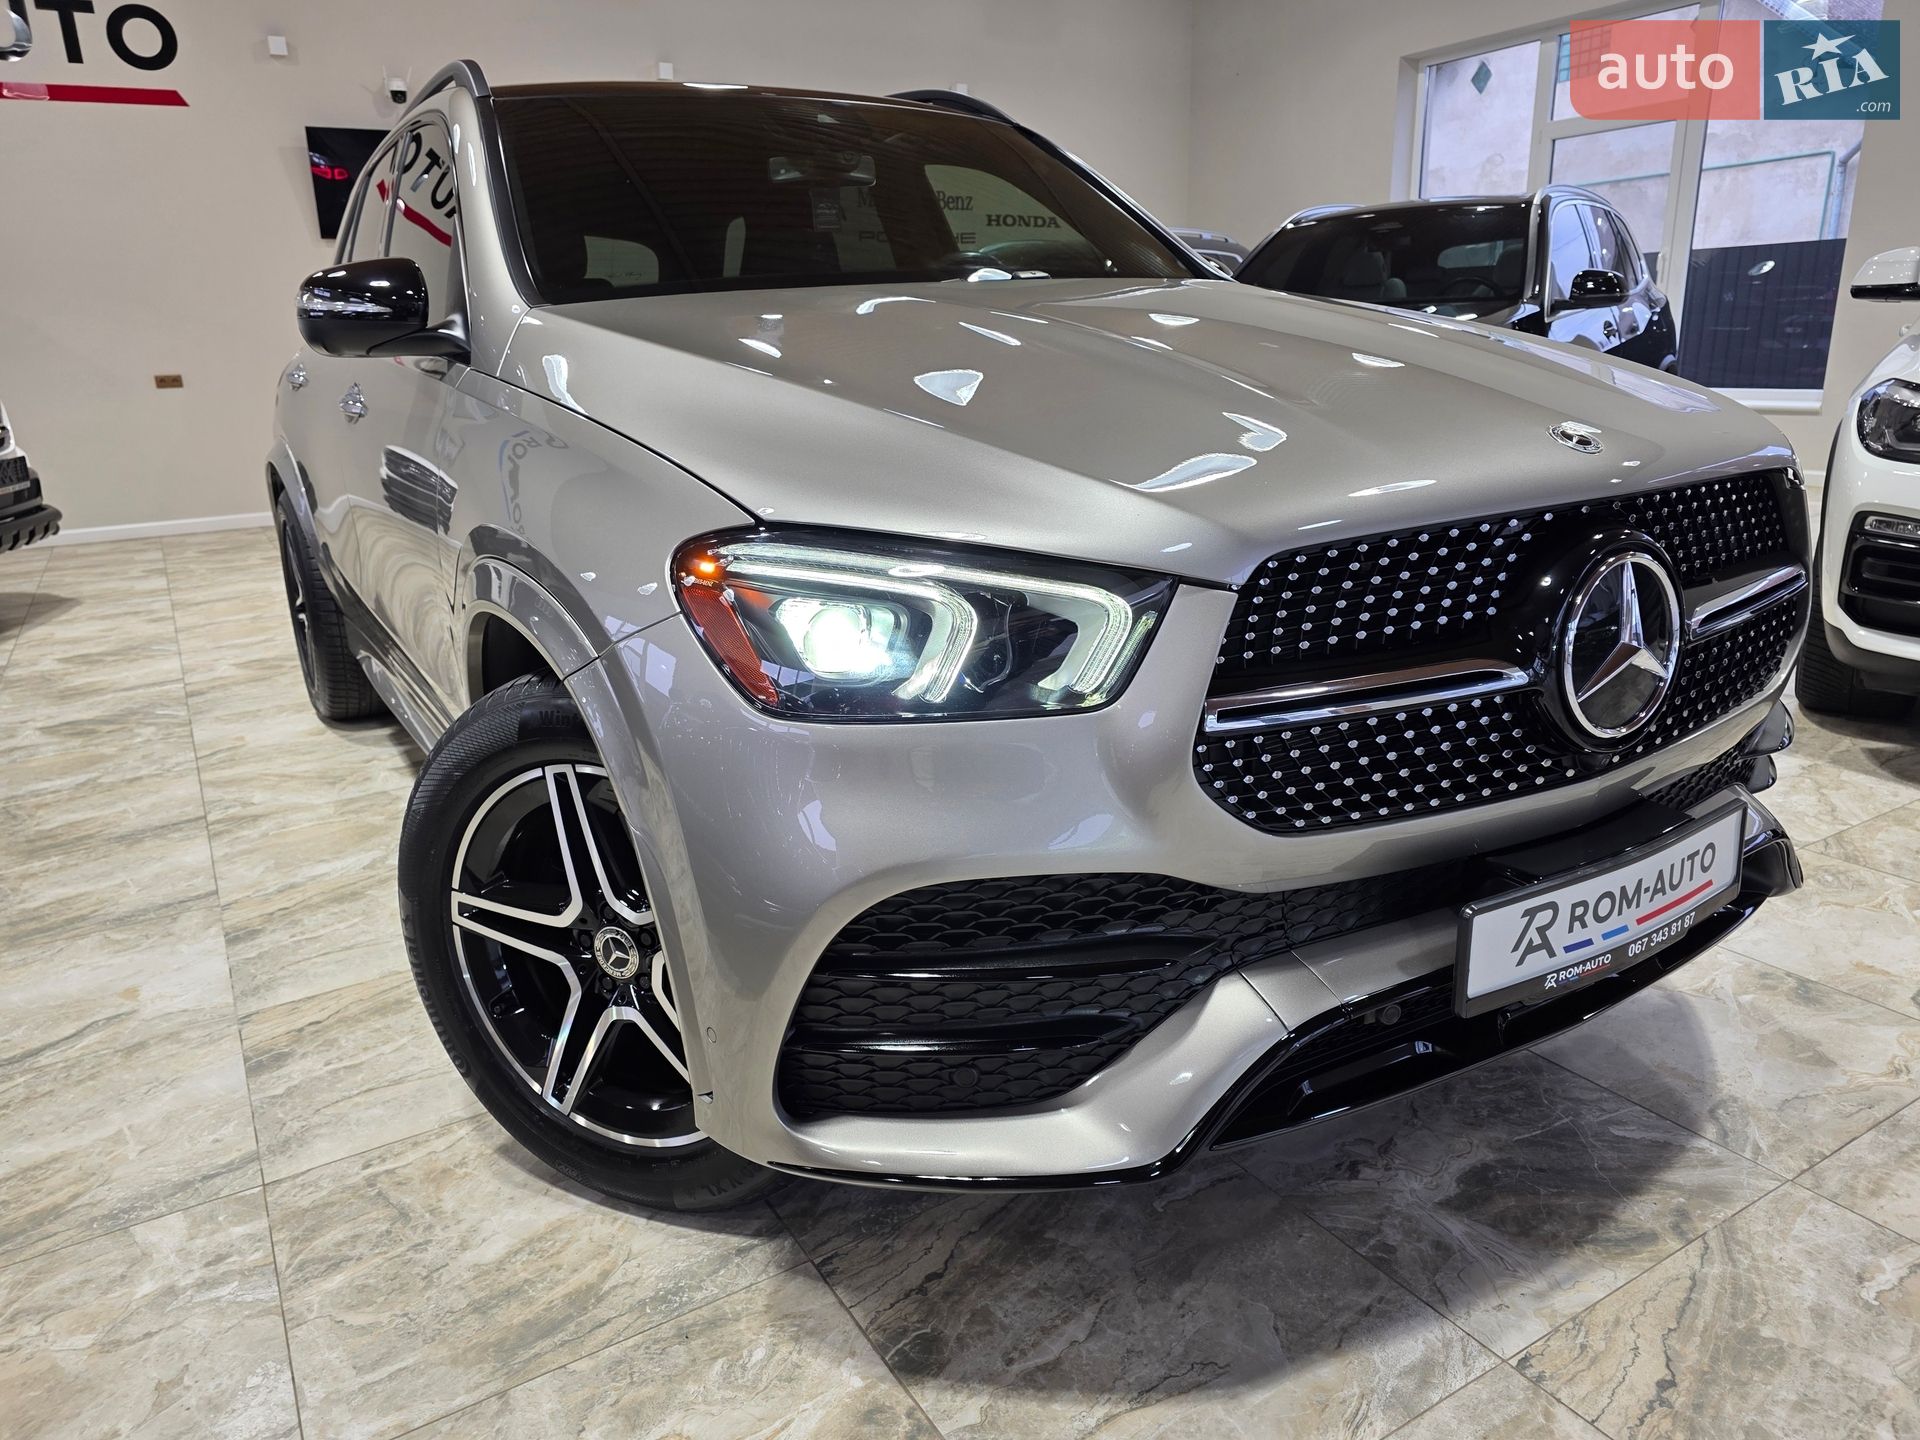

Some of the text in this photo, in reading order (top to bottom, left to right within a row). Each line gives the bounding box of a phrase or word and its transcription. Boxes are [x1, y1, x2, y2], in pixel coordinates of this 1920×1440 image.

[986, 214, 1061, 229] HONDA
[1567, 841, 1716, 935] ROM-AUTO
[1628, 911, 1696, 958] 067 343 81 87
[1558, 953, 1612, 981] ROM-AUTO
